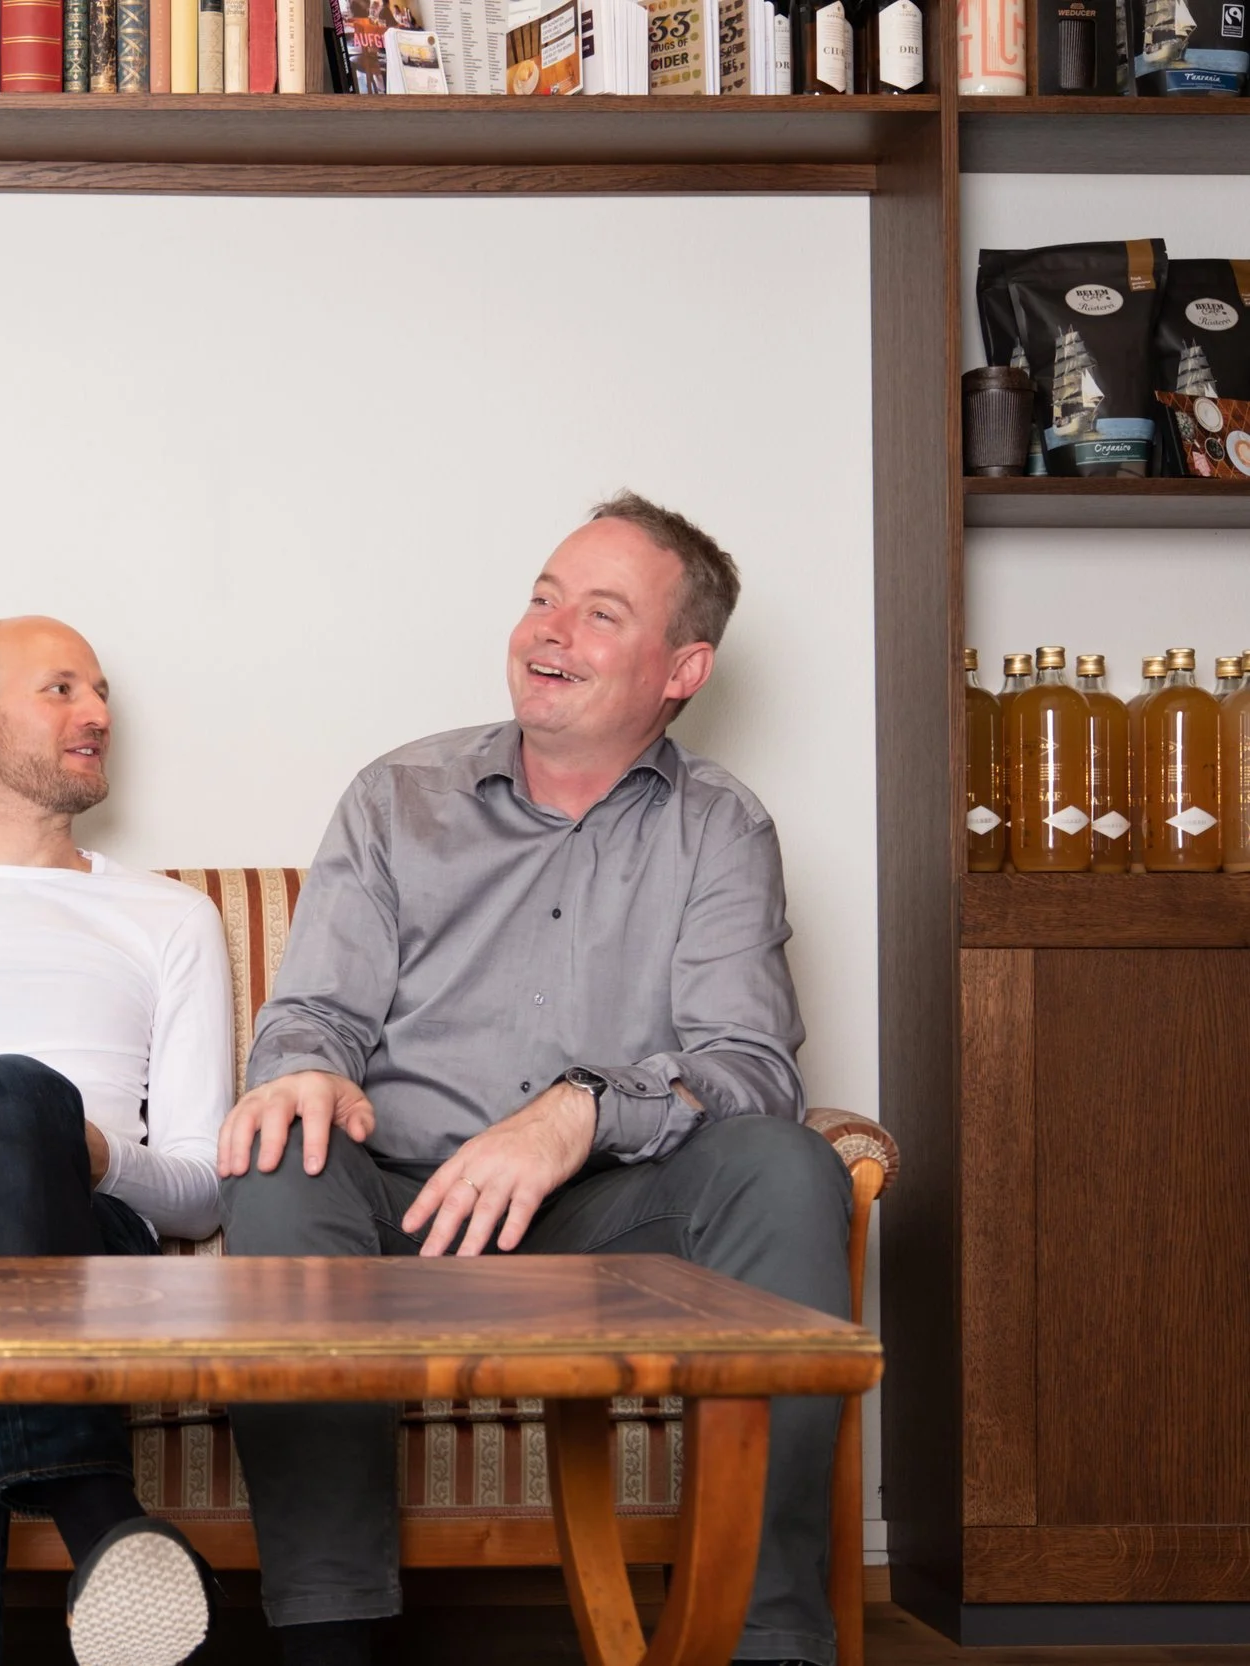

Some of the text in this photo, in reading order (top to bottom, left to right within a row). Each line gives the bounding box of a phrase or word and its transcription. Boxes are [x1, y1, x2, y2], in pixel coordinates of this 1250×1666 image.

[1058, 9, 1097, 17] WEDUCER
[648, 9, 693, 43] 33
[650, 38, 689, 54] MUGS OF
[650, 52, 689, 71] CIDER
